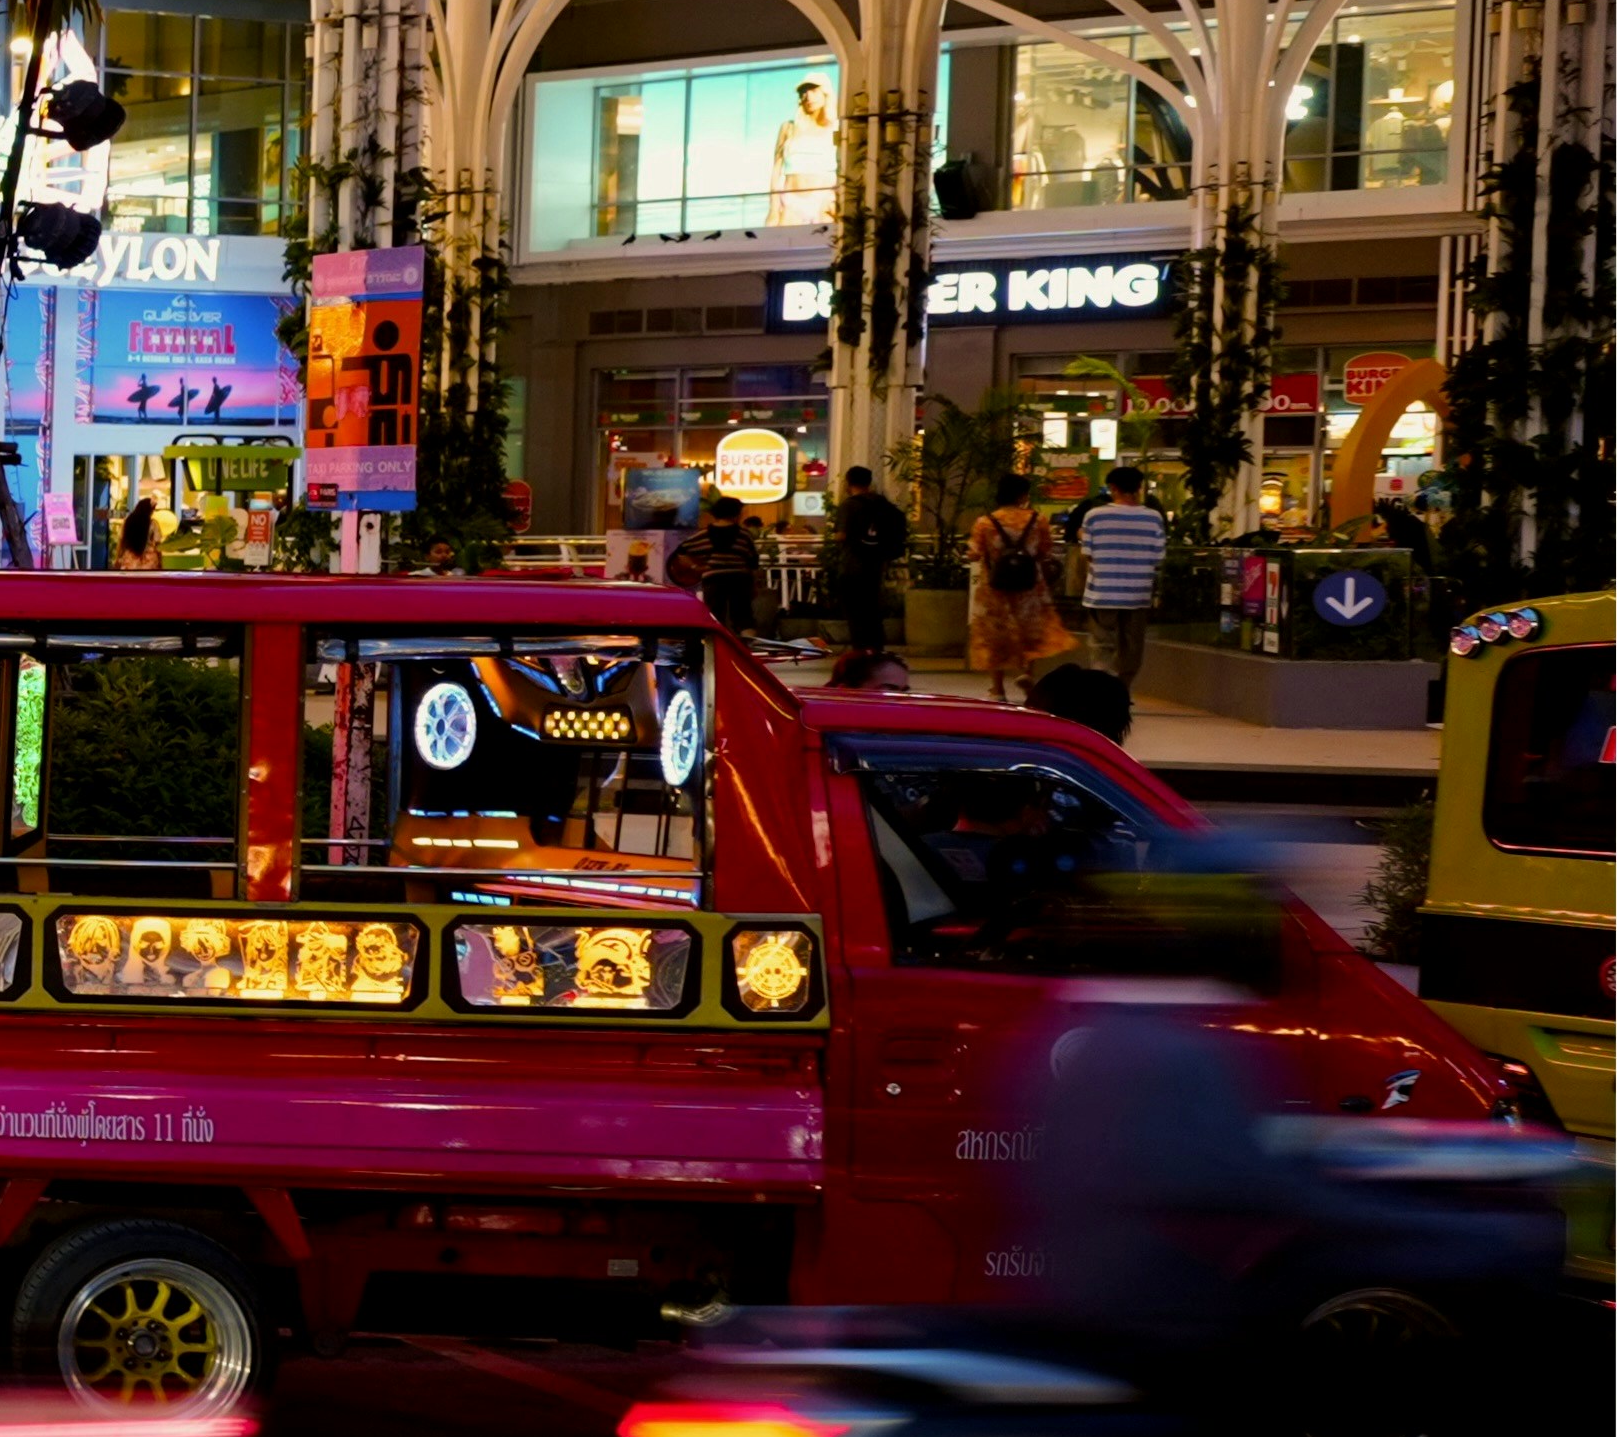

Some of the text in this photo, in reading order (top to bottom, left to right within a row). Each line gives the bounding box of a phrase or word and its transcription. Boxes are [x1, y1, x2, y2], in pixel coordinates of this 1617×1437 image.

[1008, 263, 1160, 312] KING
[127, 319, 237, 356] FESTIVAL
[1346, 368, 1404, 380] BURG
[330, 462, 373, 474] PARKING
[377, 461, 412, 474] ONLY
[720, 454, 784, 467] BURGER
[720, 468, 783, 486] KING
[250, 514, 267, 525] NO
[154, 1113, 174, 1142] 11
[181, 1104, 215, 1143] ที่นั่ง
